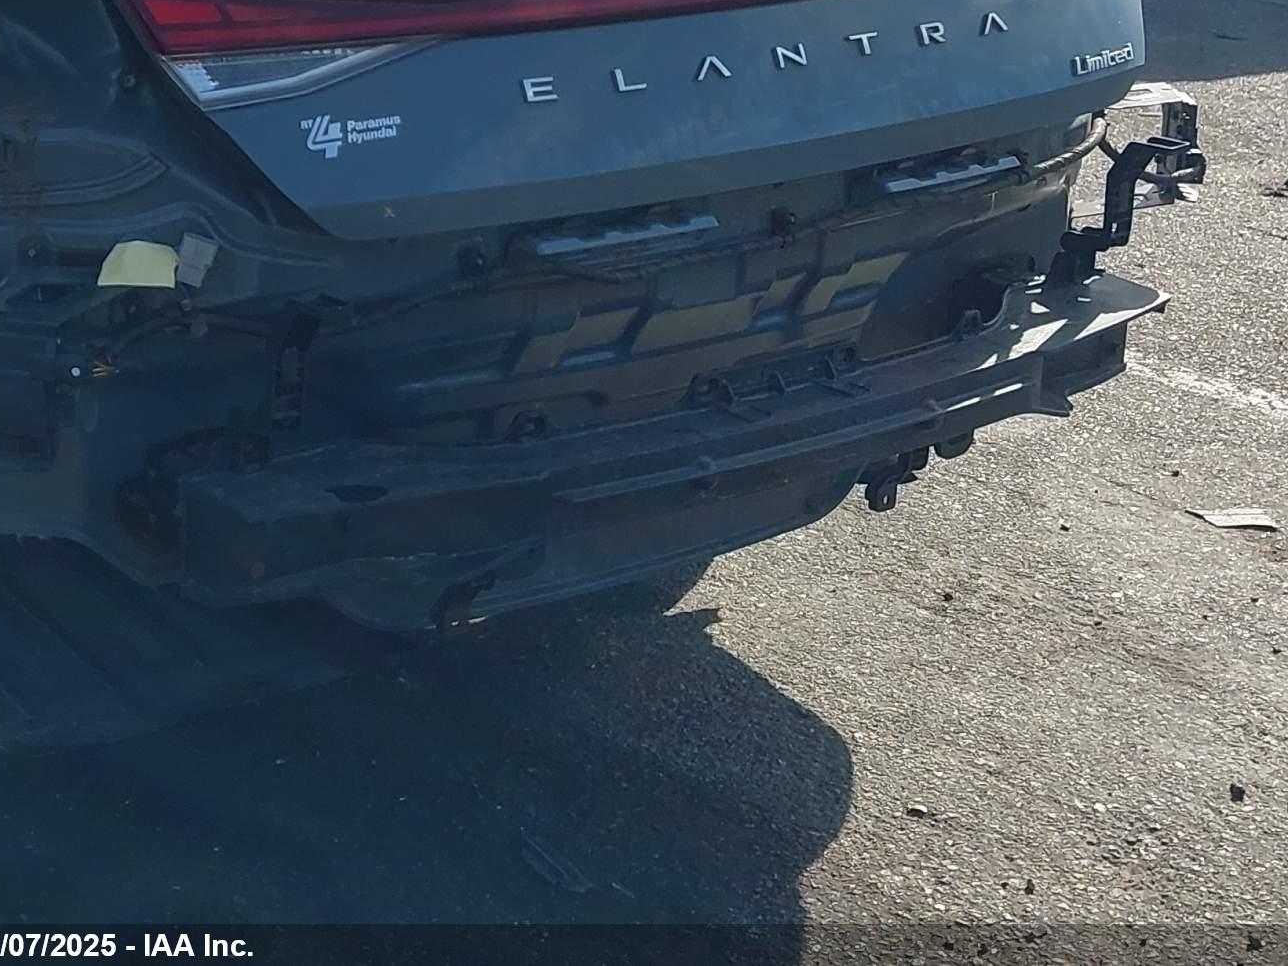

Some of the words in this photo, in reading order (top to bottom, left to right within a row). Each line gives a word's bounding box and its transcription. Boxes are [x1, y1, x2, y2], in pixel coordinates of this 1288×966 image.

[522, 11, 1010, 103] ELANTRA
[1073, 41, 1136, 75] Limited
[306, 114, 343, 159] 4
[346, 115, 401, 132] Paramus
[347, 125, 398, 144] Hyundai
